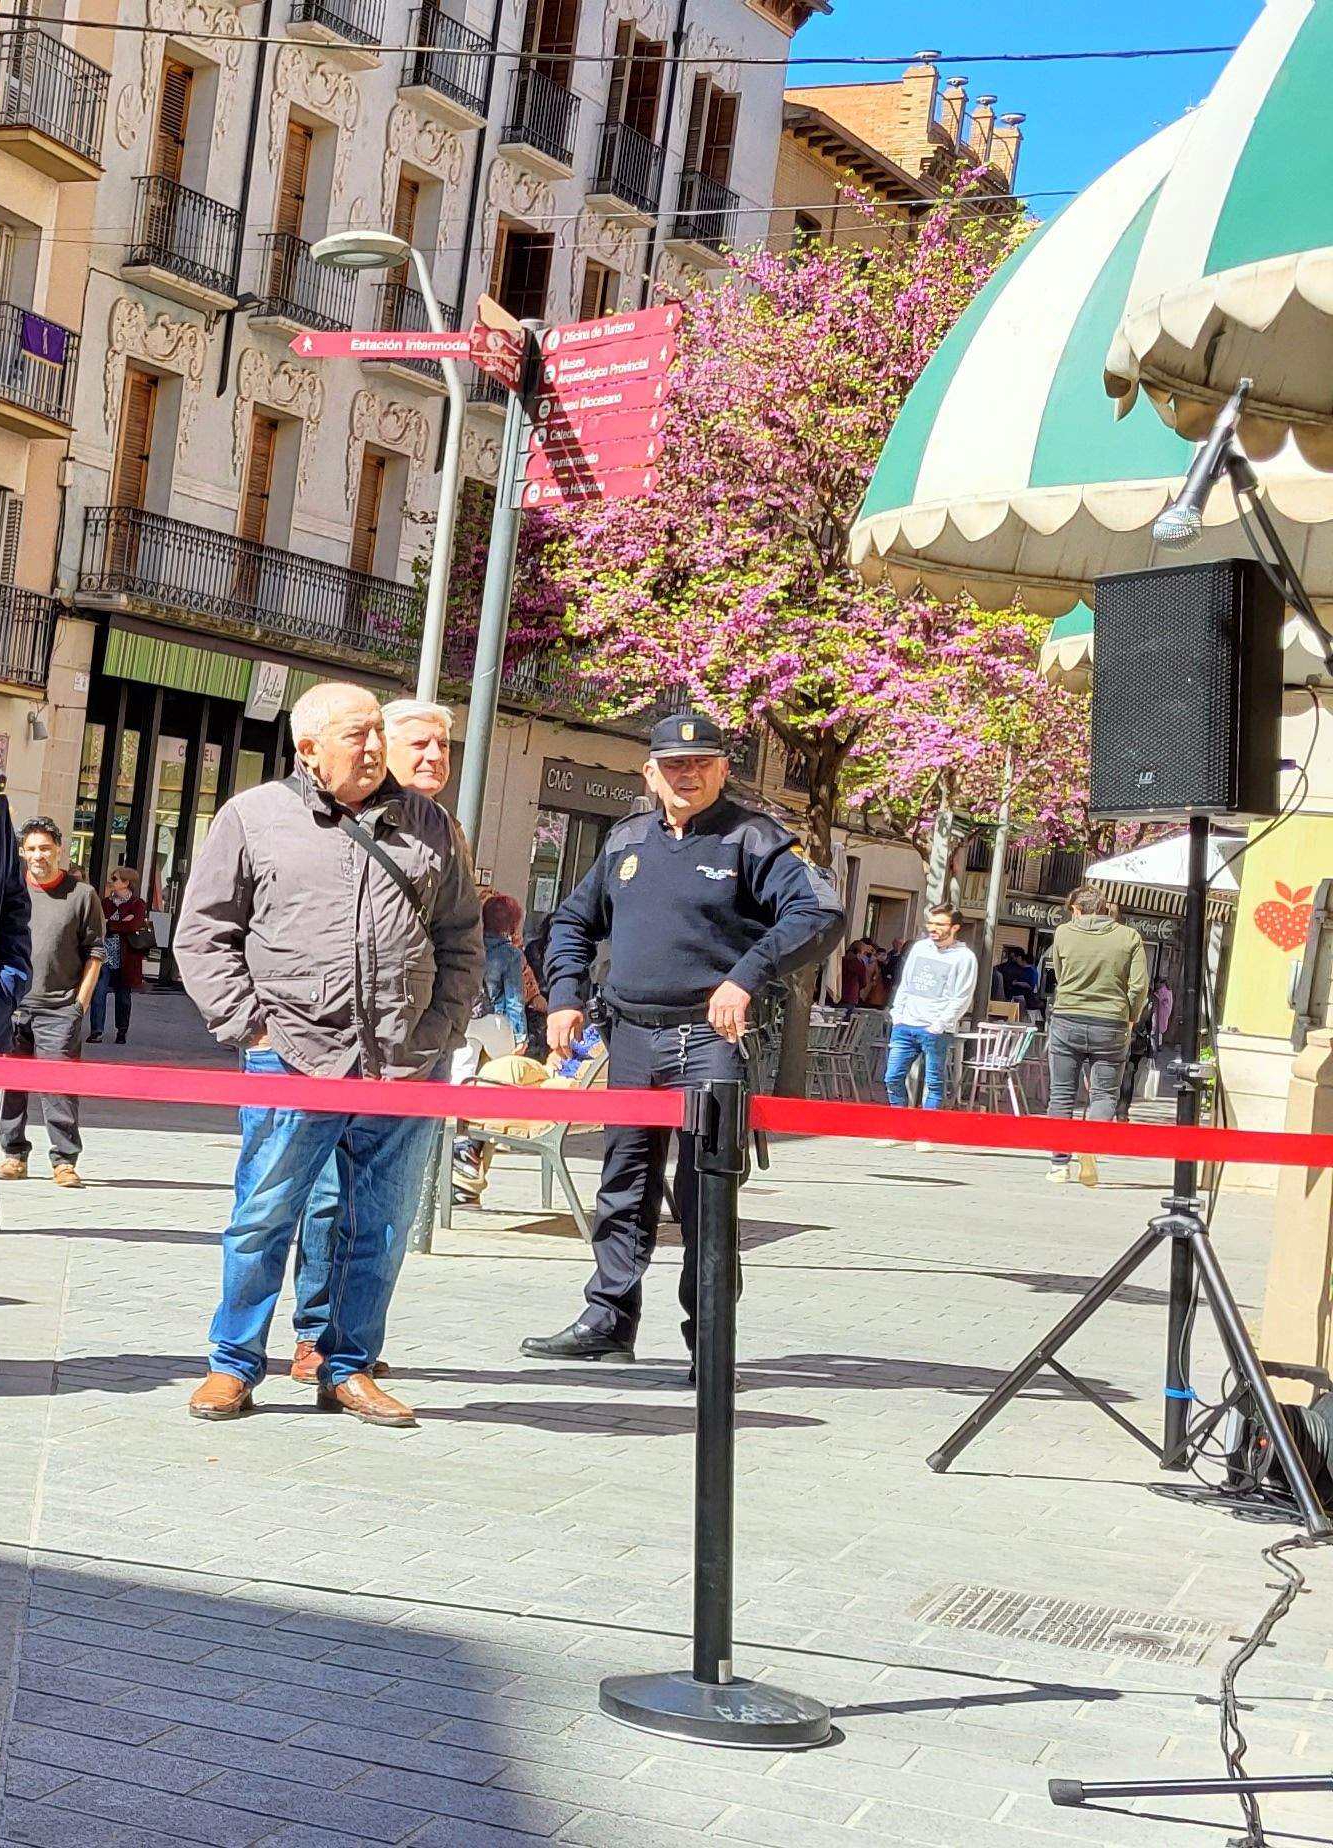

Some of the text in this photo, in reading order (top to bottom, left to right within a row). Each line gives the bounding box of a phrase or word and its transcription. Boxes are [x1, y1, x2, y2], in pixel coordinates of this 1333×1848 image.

[562, 321, 636, 343] Oficina de Turismo
[351, 338, 470, 351] Estación Intermoda
[557, 358, 649, 384] Arqueológico Provincial
[559, 358, 586, 371] Museo
[580, 393, 622, 409] Diocesano
[550, 426, 582, 440] Catedral
[546, 453, 599, 469] Ayuntamiento
[543, 481, 605, 497] Centro Histórico
[547, 768, 573, 791] CMC
[585, 782, 607, 797] MODA
